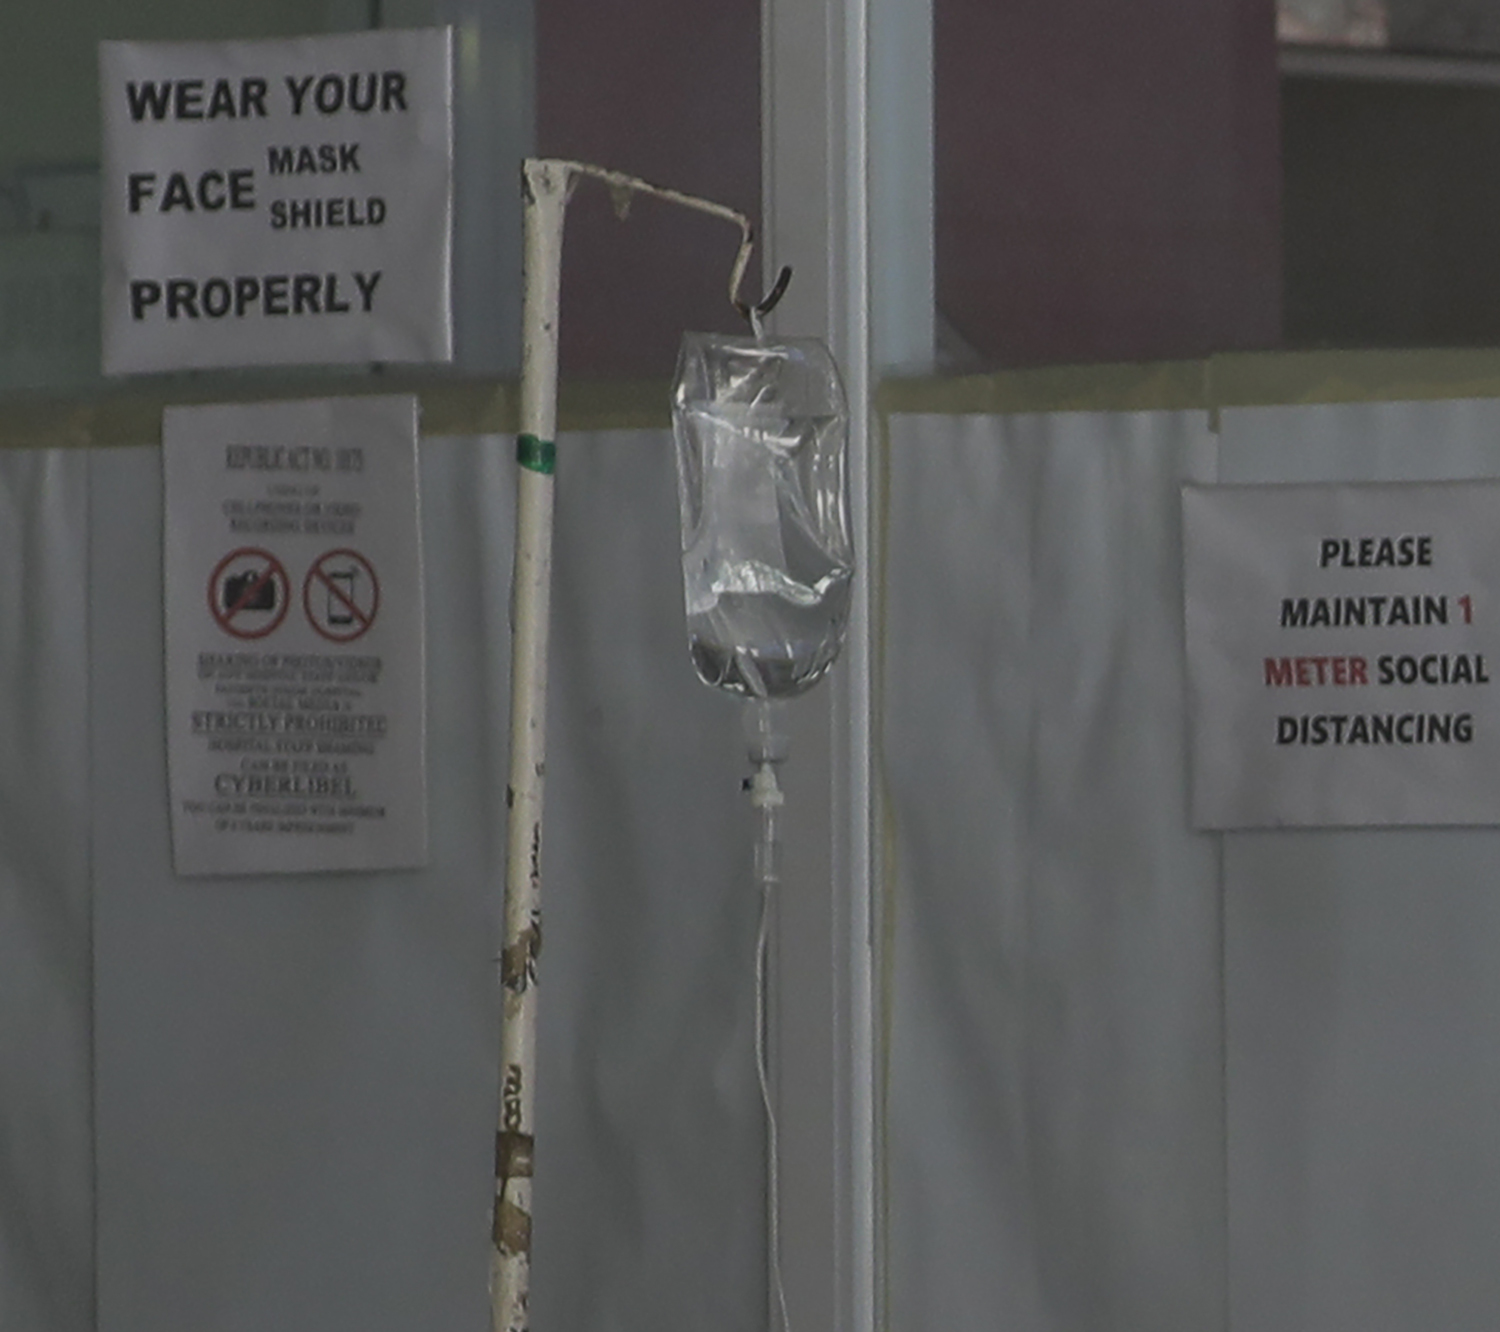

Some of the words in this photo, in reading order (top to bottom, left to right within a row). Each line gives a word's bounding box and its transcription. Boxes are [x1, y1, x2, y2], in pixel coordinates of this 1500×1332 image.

[126, 75, 270, 122] WEAR
[284, 70, 409, 117] YOUR
[267, 144, 362, 176] MASK
[128, 169, 255, 214] FACE
[270, 196, 388, 230] SHIELD
[129, 271, 384, 321] PROPERLY
[1318, 536, 1435, 570] PLEASE
[1279, 594, 1449, 629] MAINTAIN
[1456, 596, 1474, 626] 1
[1263, 656, 1369, 689] METER
[1376, 653, 1490, 686] SOCIAL
[1276, 712, 1476, 747] DISTANCING
